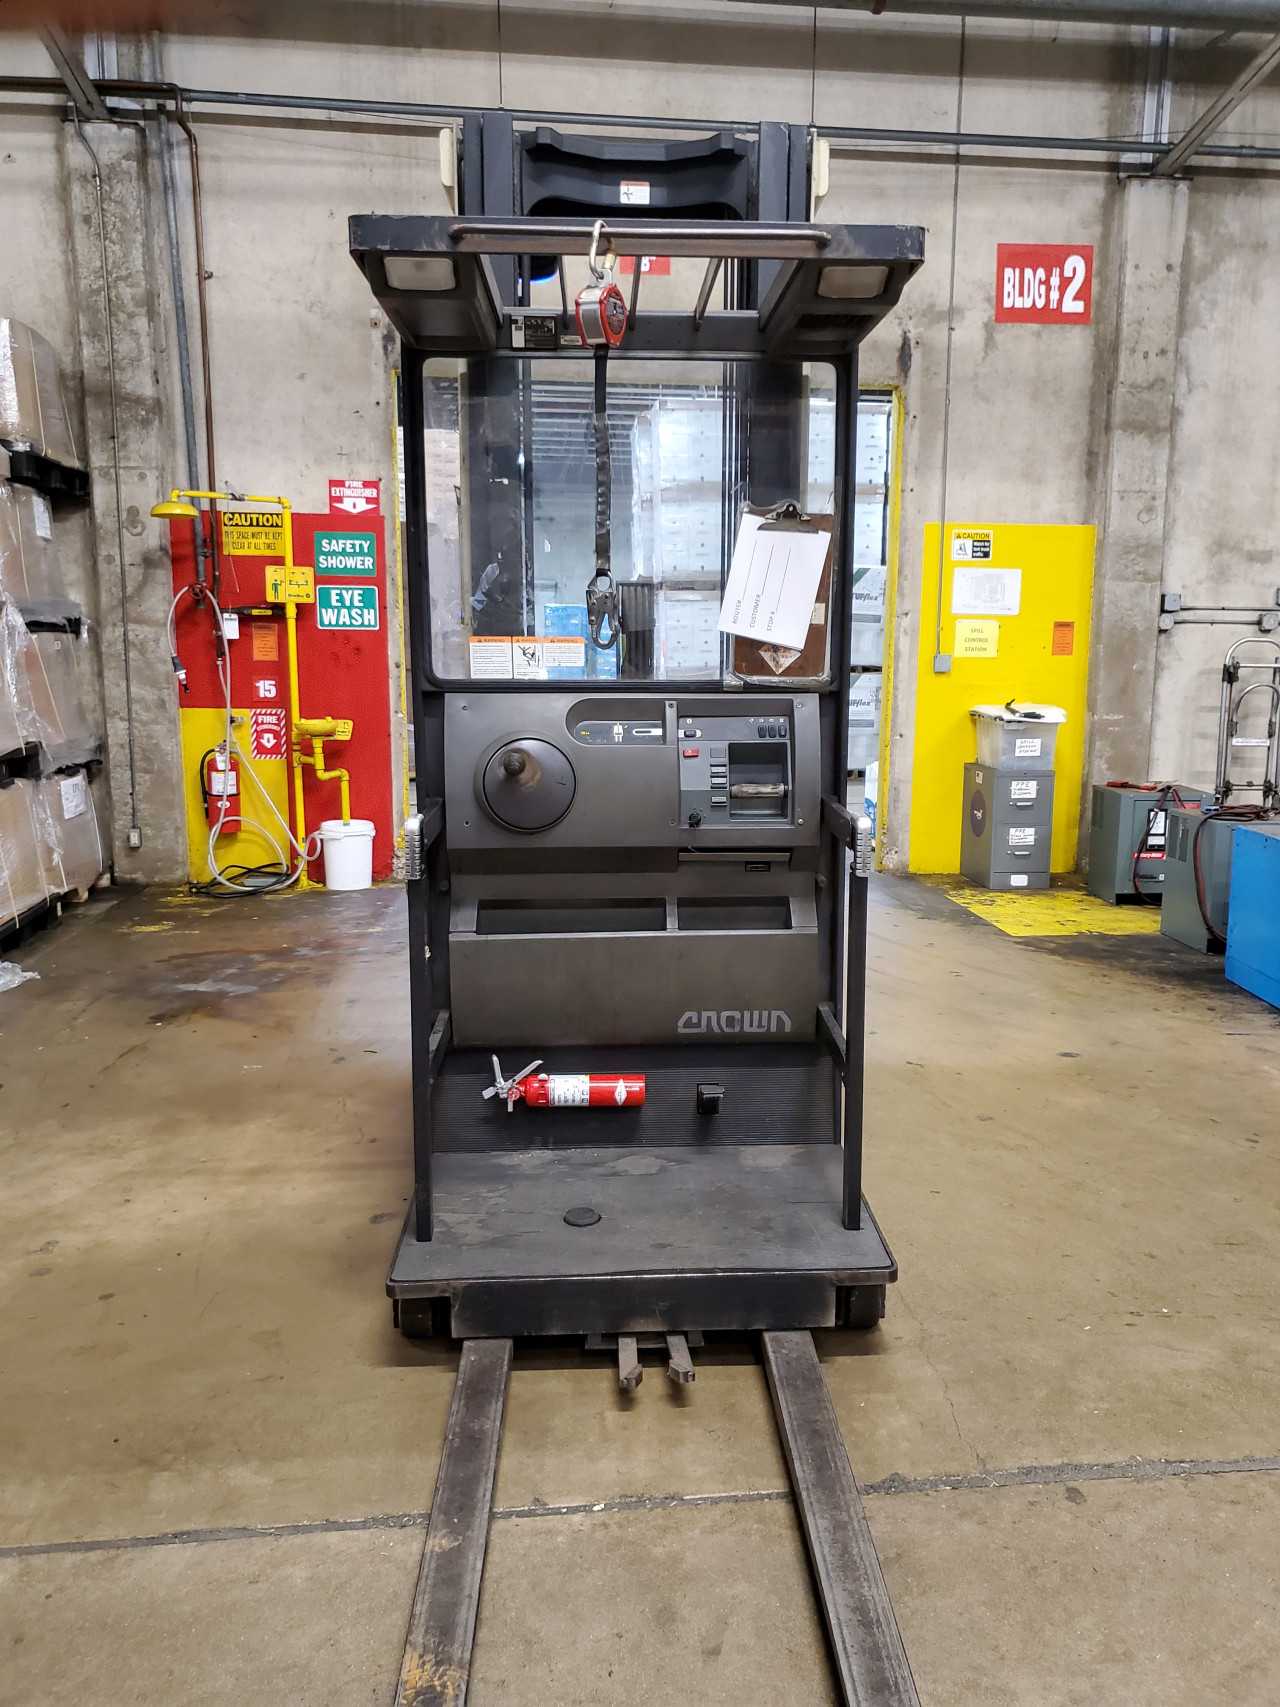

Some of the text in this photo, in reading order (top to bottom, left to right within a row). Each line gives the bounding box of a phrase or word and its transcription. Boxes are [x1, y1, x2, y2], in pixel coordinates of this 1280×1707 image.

[1003, 267, 1046, 309] BLDG
[344, 480, 364, 488] FIRE
[223, 513, 283, 526] CAUTION
[962, 532, 991, 540] CAUTION
[321, 539, 370, 553] SAFETY
[319, 555, 374, 569] SHOWER
[331, 589, 364, 607] EYE
[321, 608, 375, 625] WASH
[255, 680, 277, 698] 15
[258, 715, 279, 724] FIRE
[677, 1010, 792, 1033] CROWN
